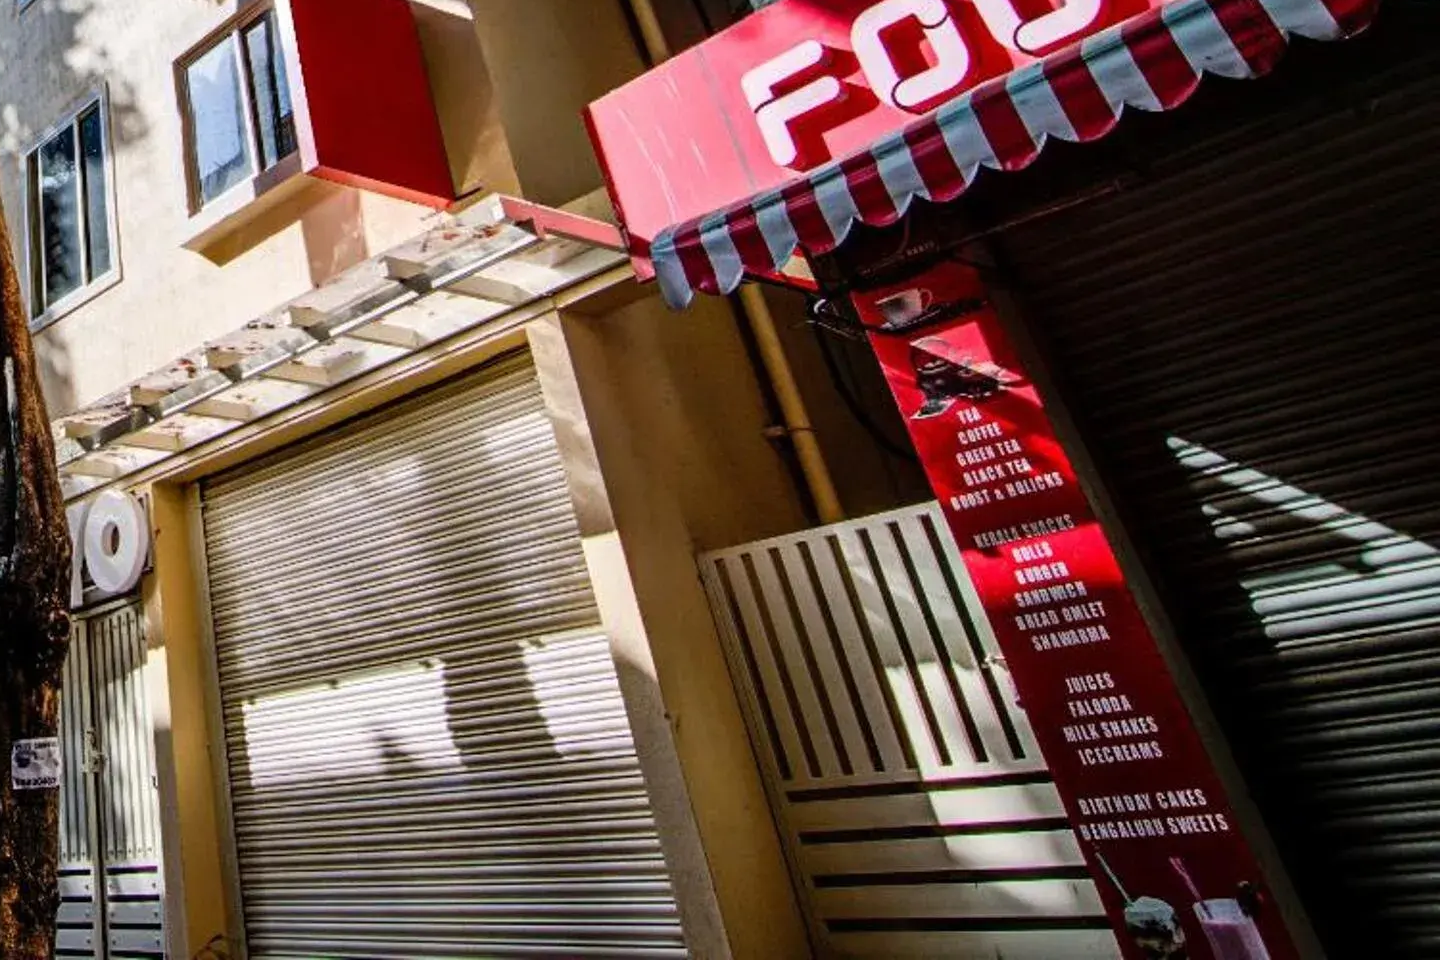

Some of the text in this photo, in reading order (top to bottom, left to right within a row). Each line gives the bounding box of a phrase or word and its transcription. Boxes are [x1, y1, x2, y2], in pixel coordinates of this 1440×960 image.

[957, 406, 981, 424] TEA
[957, 422, 1002, 445] COFFEE
[955, 439, 1021, 467] GREEN TEA
[963, 458, 1032, 487] BLACK TEA
[950, 472, 1064, 512] BOOST & HOLICKS
[973, 514, 1074, 549] KERALA SNACKS
[1012, 541, 1053, 564] ROLLS
[1014, 561, 1069, 584] BURGER
[1015, 581, 1088, 608] SANDWICH
[1015, 600, 1107, 631] BREAD OMLET
[1032, 624, 1110, 651] SHAWARMA
[1065, 672, 1115, 694] JUICES
[1067, 695, 1133, 718] FALOODA
[1063, 715, 1158, 743] MILK SHAKES
[1078, 741, 1163, 766] ICECREAMS
[1078, 788, 1207, 816] BIRTHDAY CAKES
[1079, 813, 1229, 841] BENGALURU SWEETS
